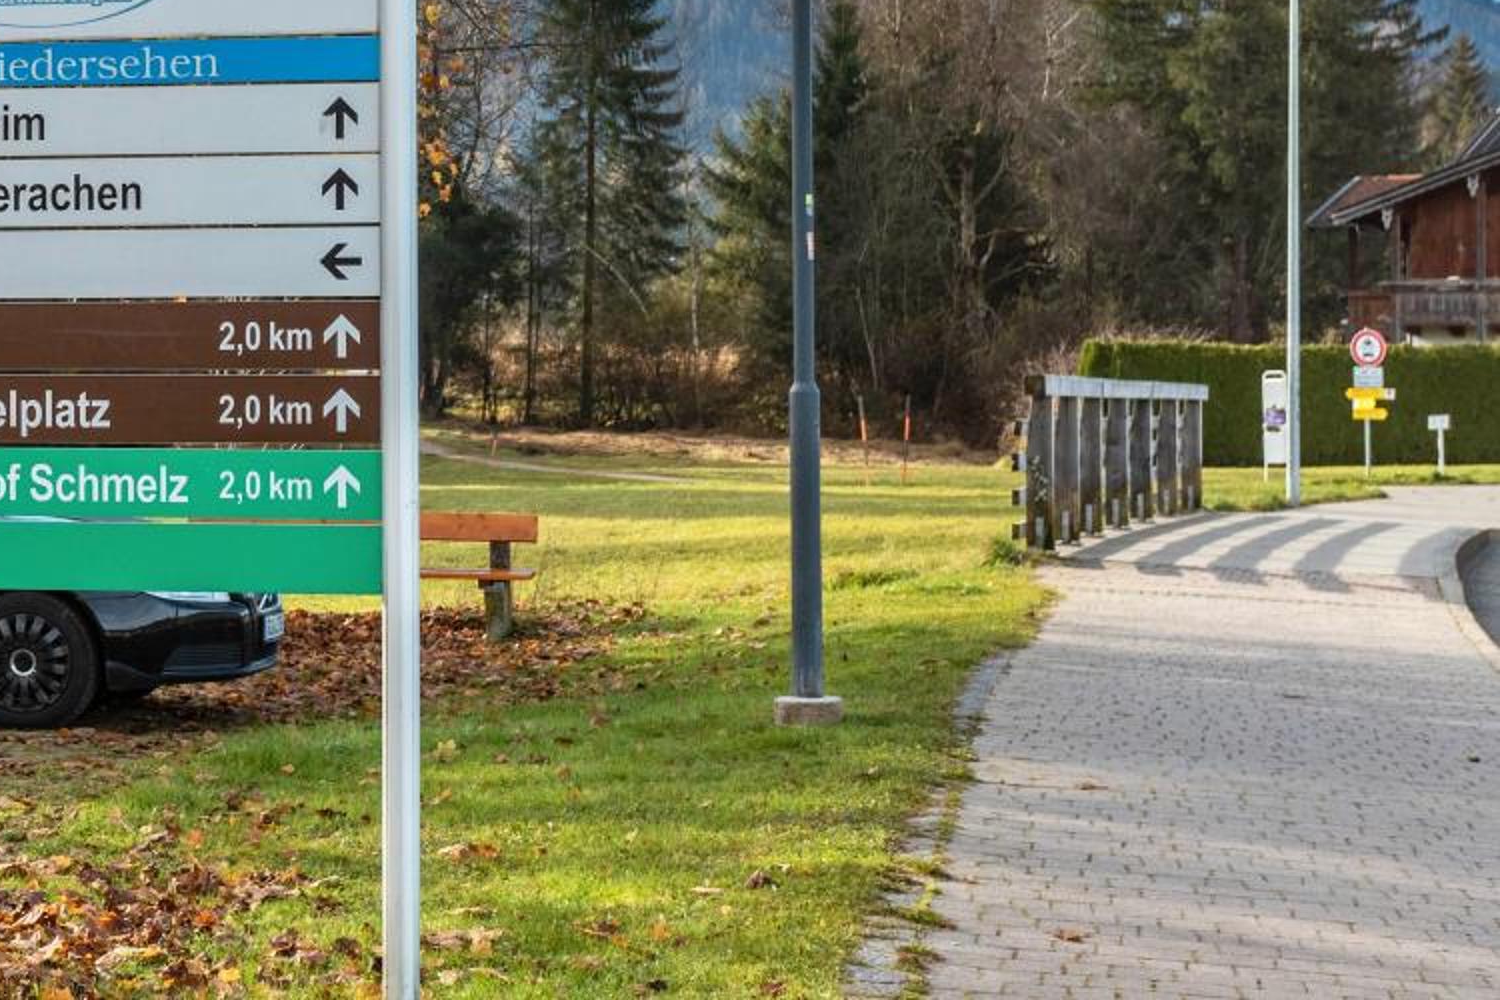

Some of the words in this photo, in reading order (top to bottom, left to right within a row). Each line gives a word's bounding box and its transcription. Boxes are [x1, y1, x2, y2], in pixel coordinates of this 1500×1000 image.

[218, 320, 261, 355] 2,0
[268, 321, 312, 351] km
[218, 393, 261, 428] 2,0
[268, 394, 312, 424] km
[29, 463, 188, 504] Schmelz
[218, 469, 261, 503] 2,0
[268, 471, 312, 500] km
